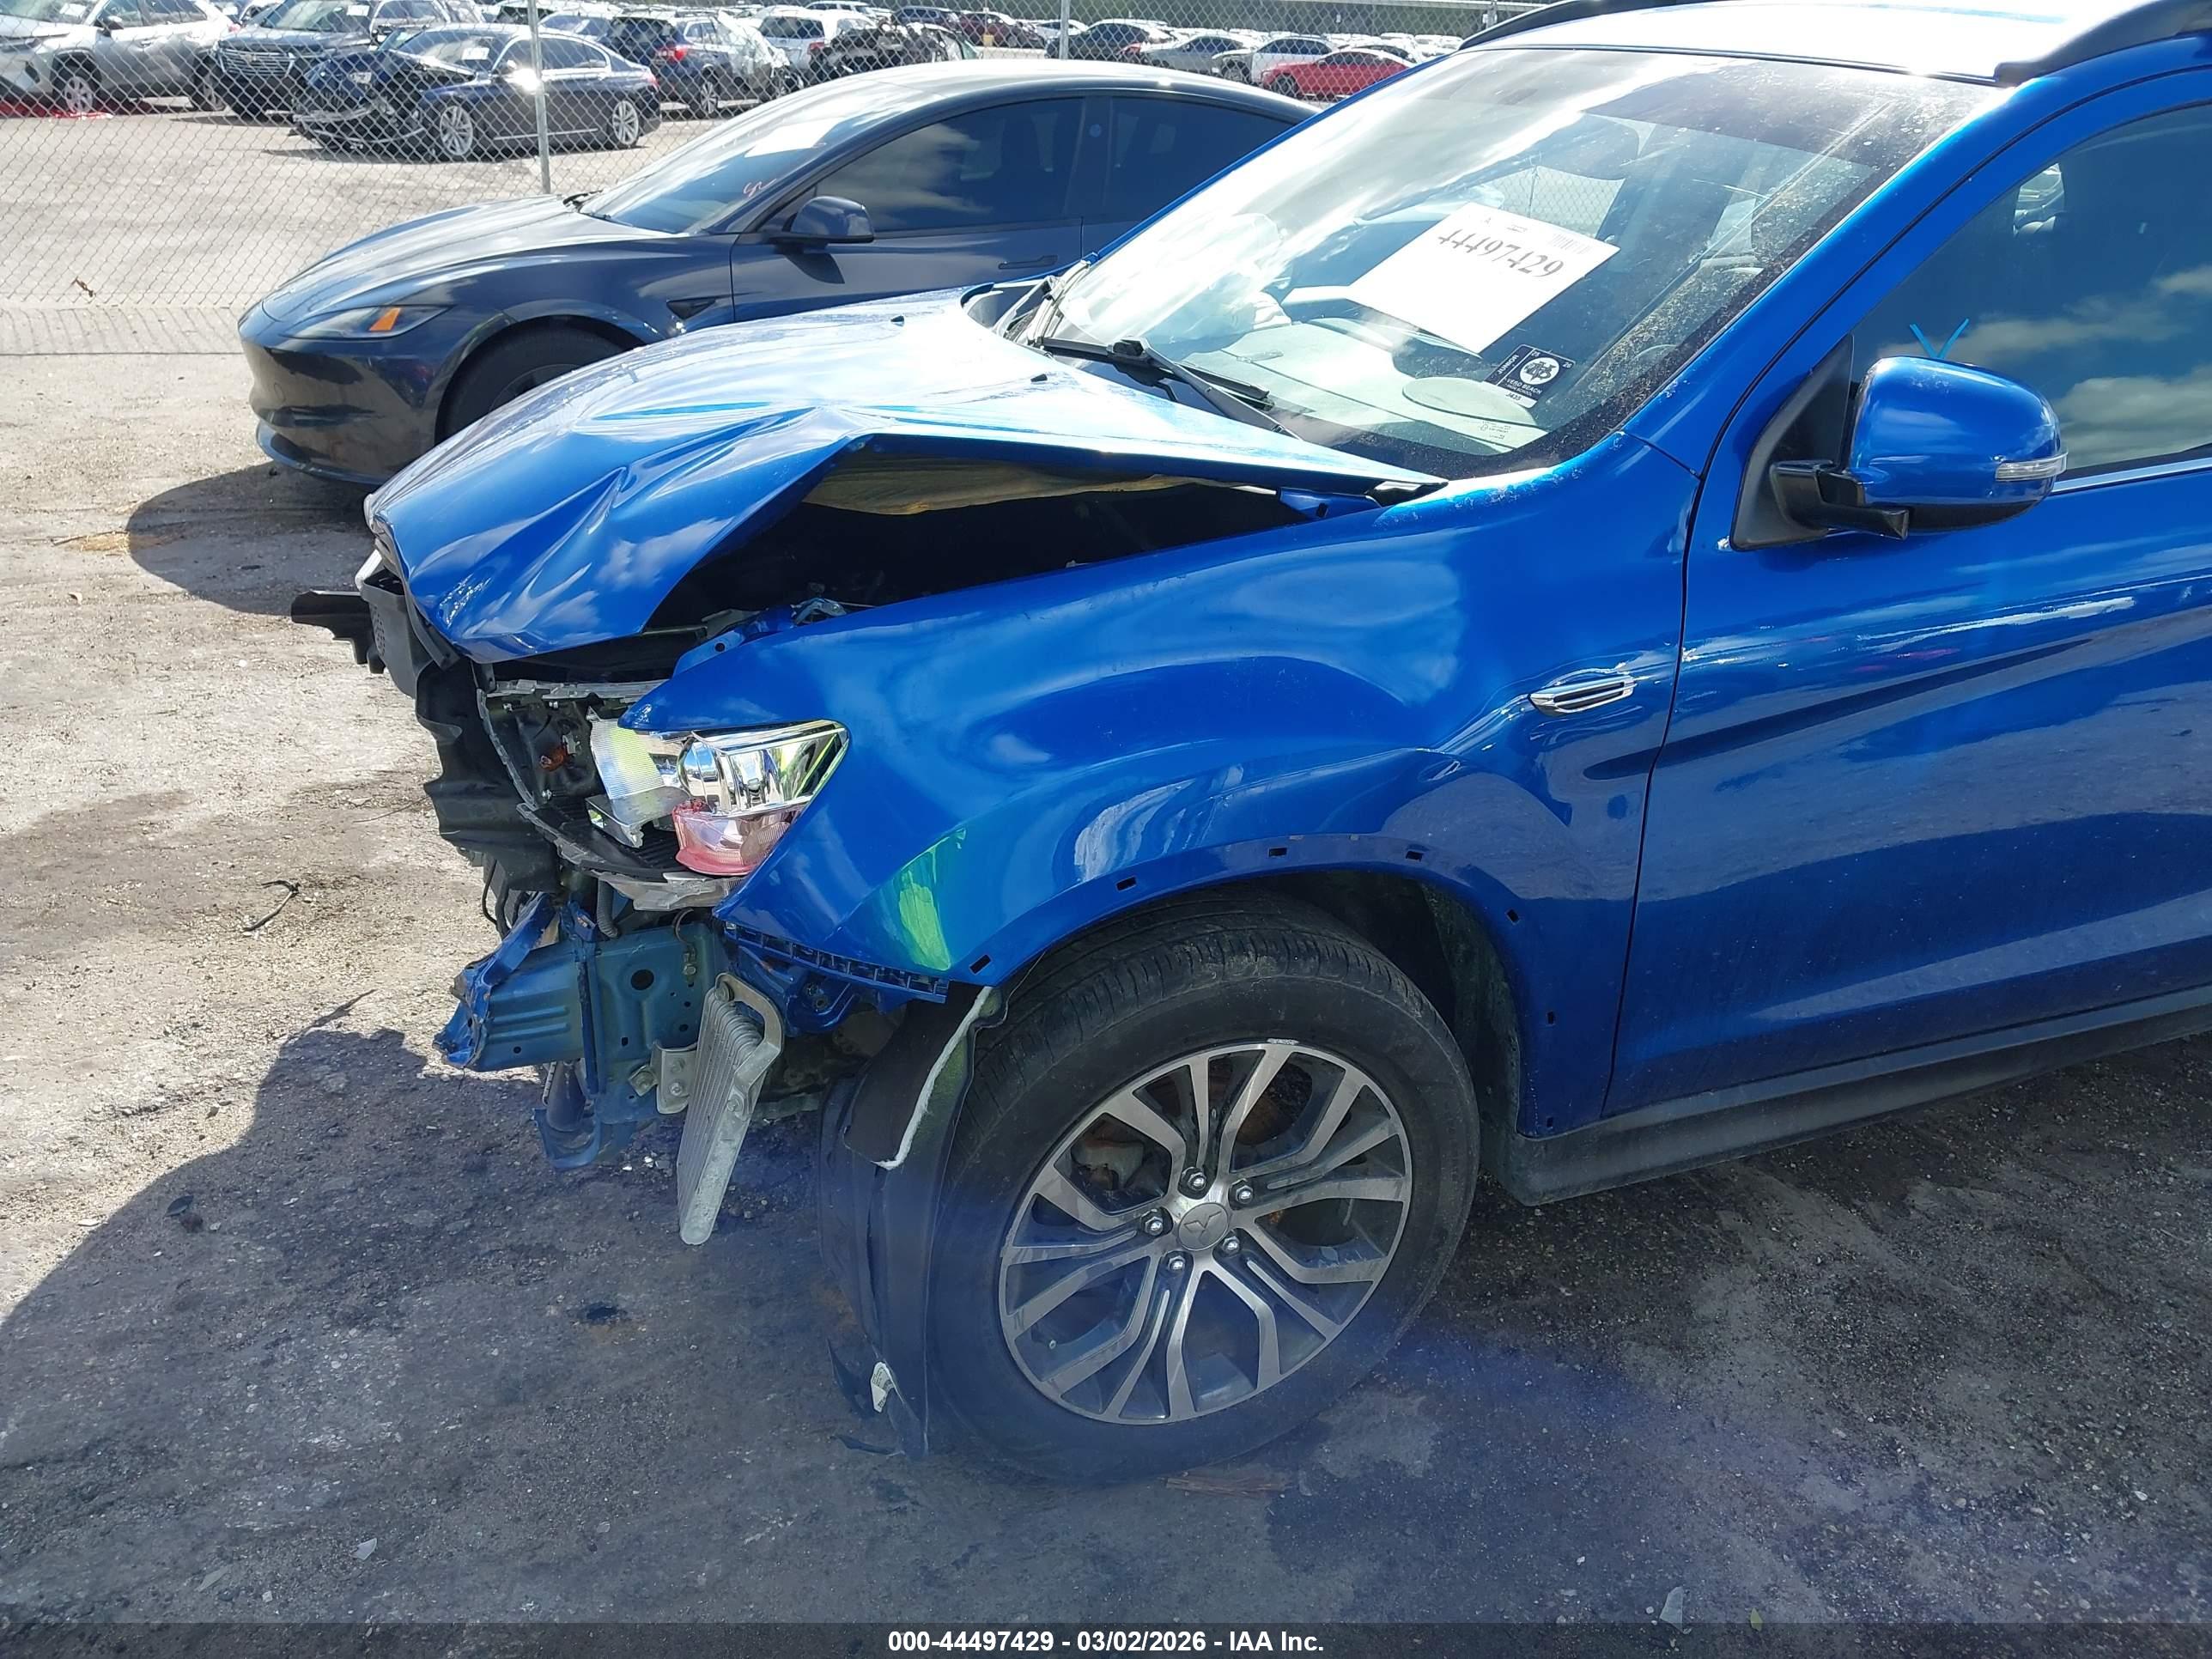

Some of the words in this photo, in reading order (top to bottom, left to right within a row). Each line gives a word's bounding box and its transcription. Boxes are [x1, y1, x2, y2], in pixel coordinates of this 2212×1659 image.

[1438, 228, 1565, 277] 44497429
[1497, 354, 1520, 374] JUNIOR
[1506, 378, 1522, 387] VERO
[1522, 383, 1543, 394] BEACH
